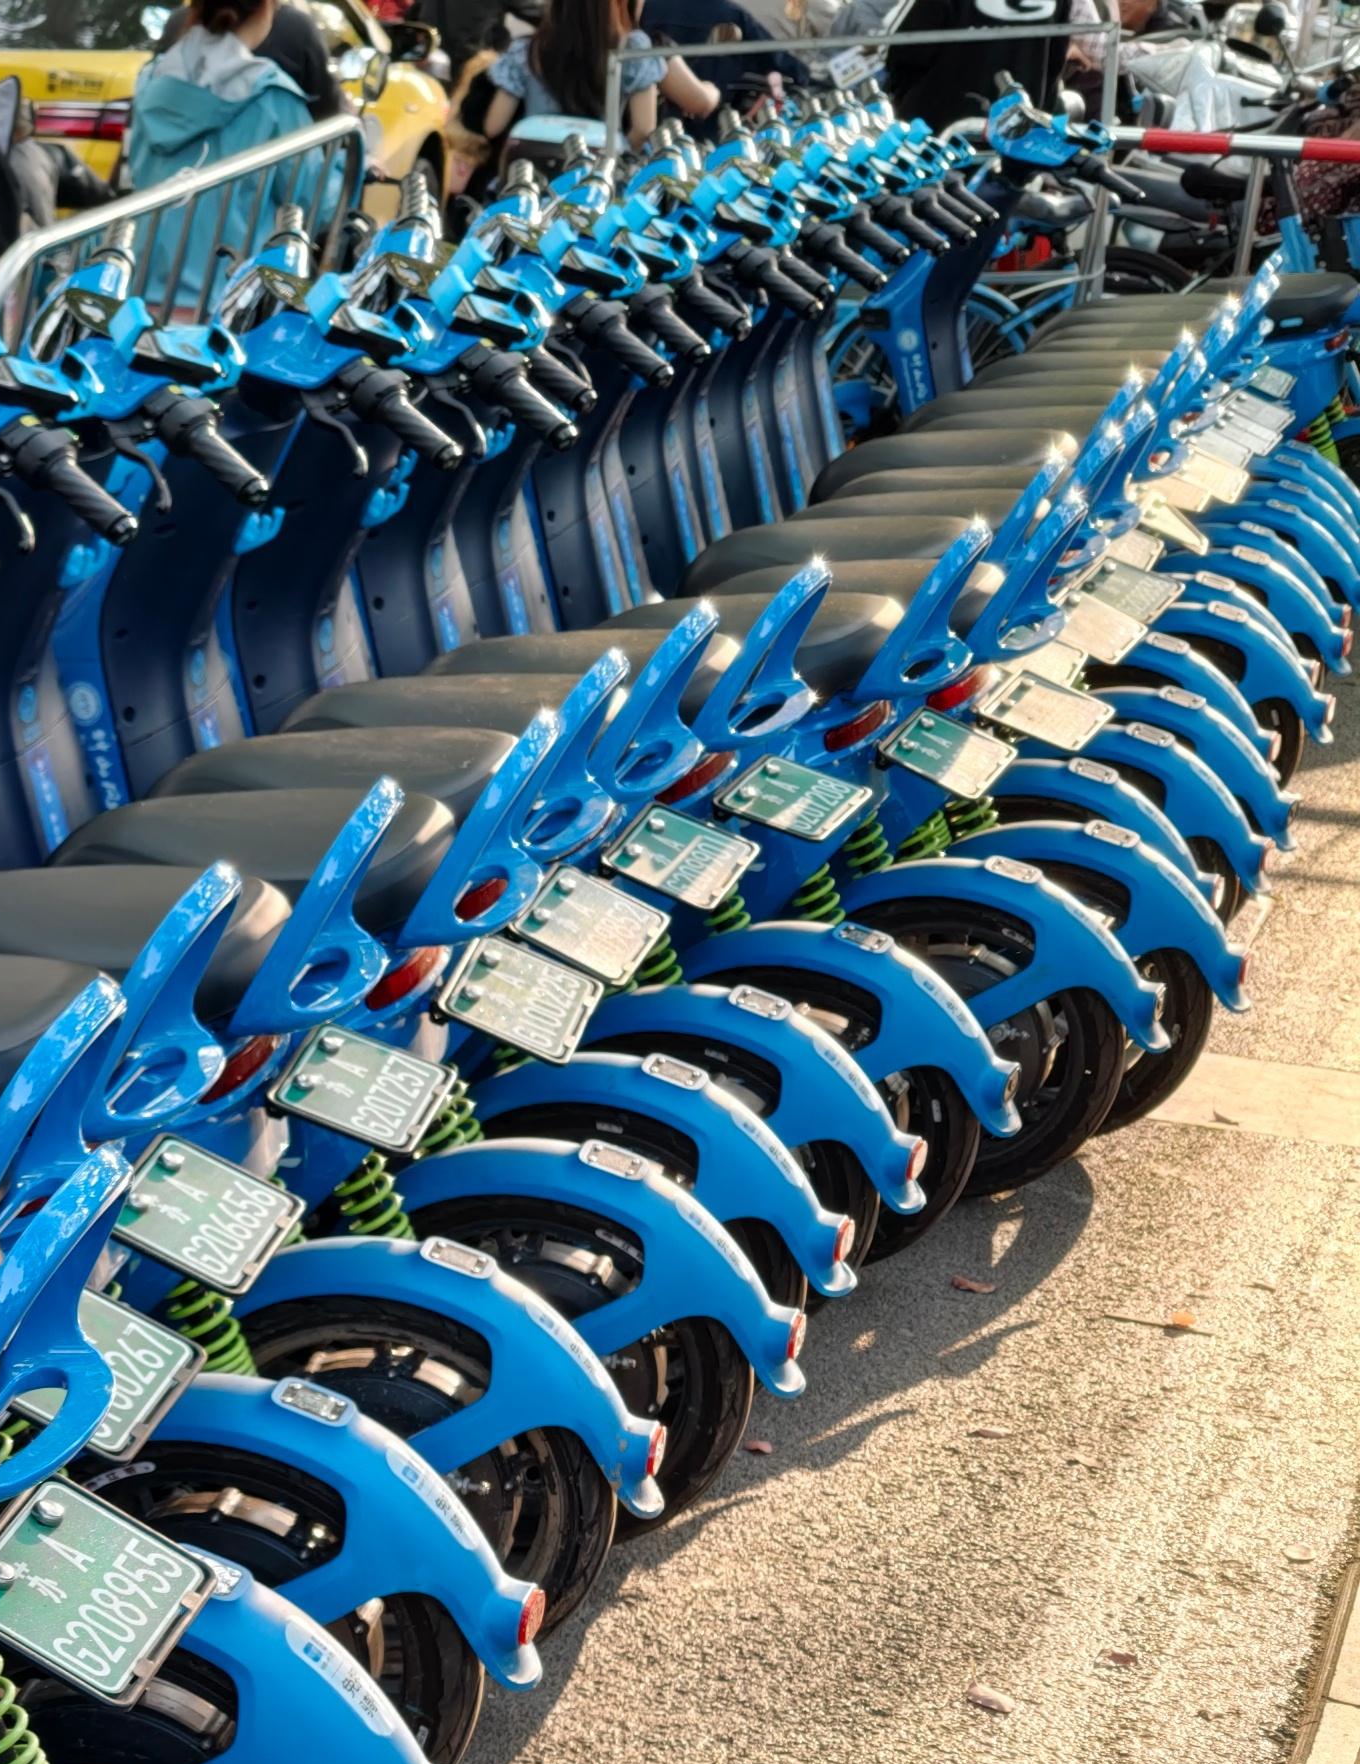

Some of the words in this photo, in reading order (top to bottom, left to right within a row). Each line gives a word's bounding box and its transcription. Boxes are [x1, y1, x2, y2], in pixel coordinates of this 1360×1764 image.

[325, 1057, 369, 1079] A
[350, 1055, 430, 1138] G207257
[162, 1175, 209, 1204] A
[182, 1181, 277, 1275] G206656
[37, 1533, 95, 1573] A
[13, 1561, 67, 1604] 苏
[52, 1538, 183, 1677] G208955
